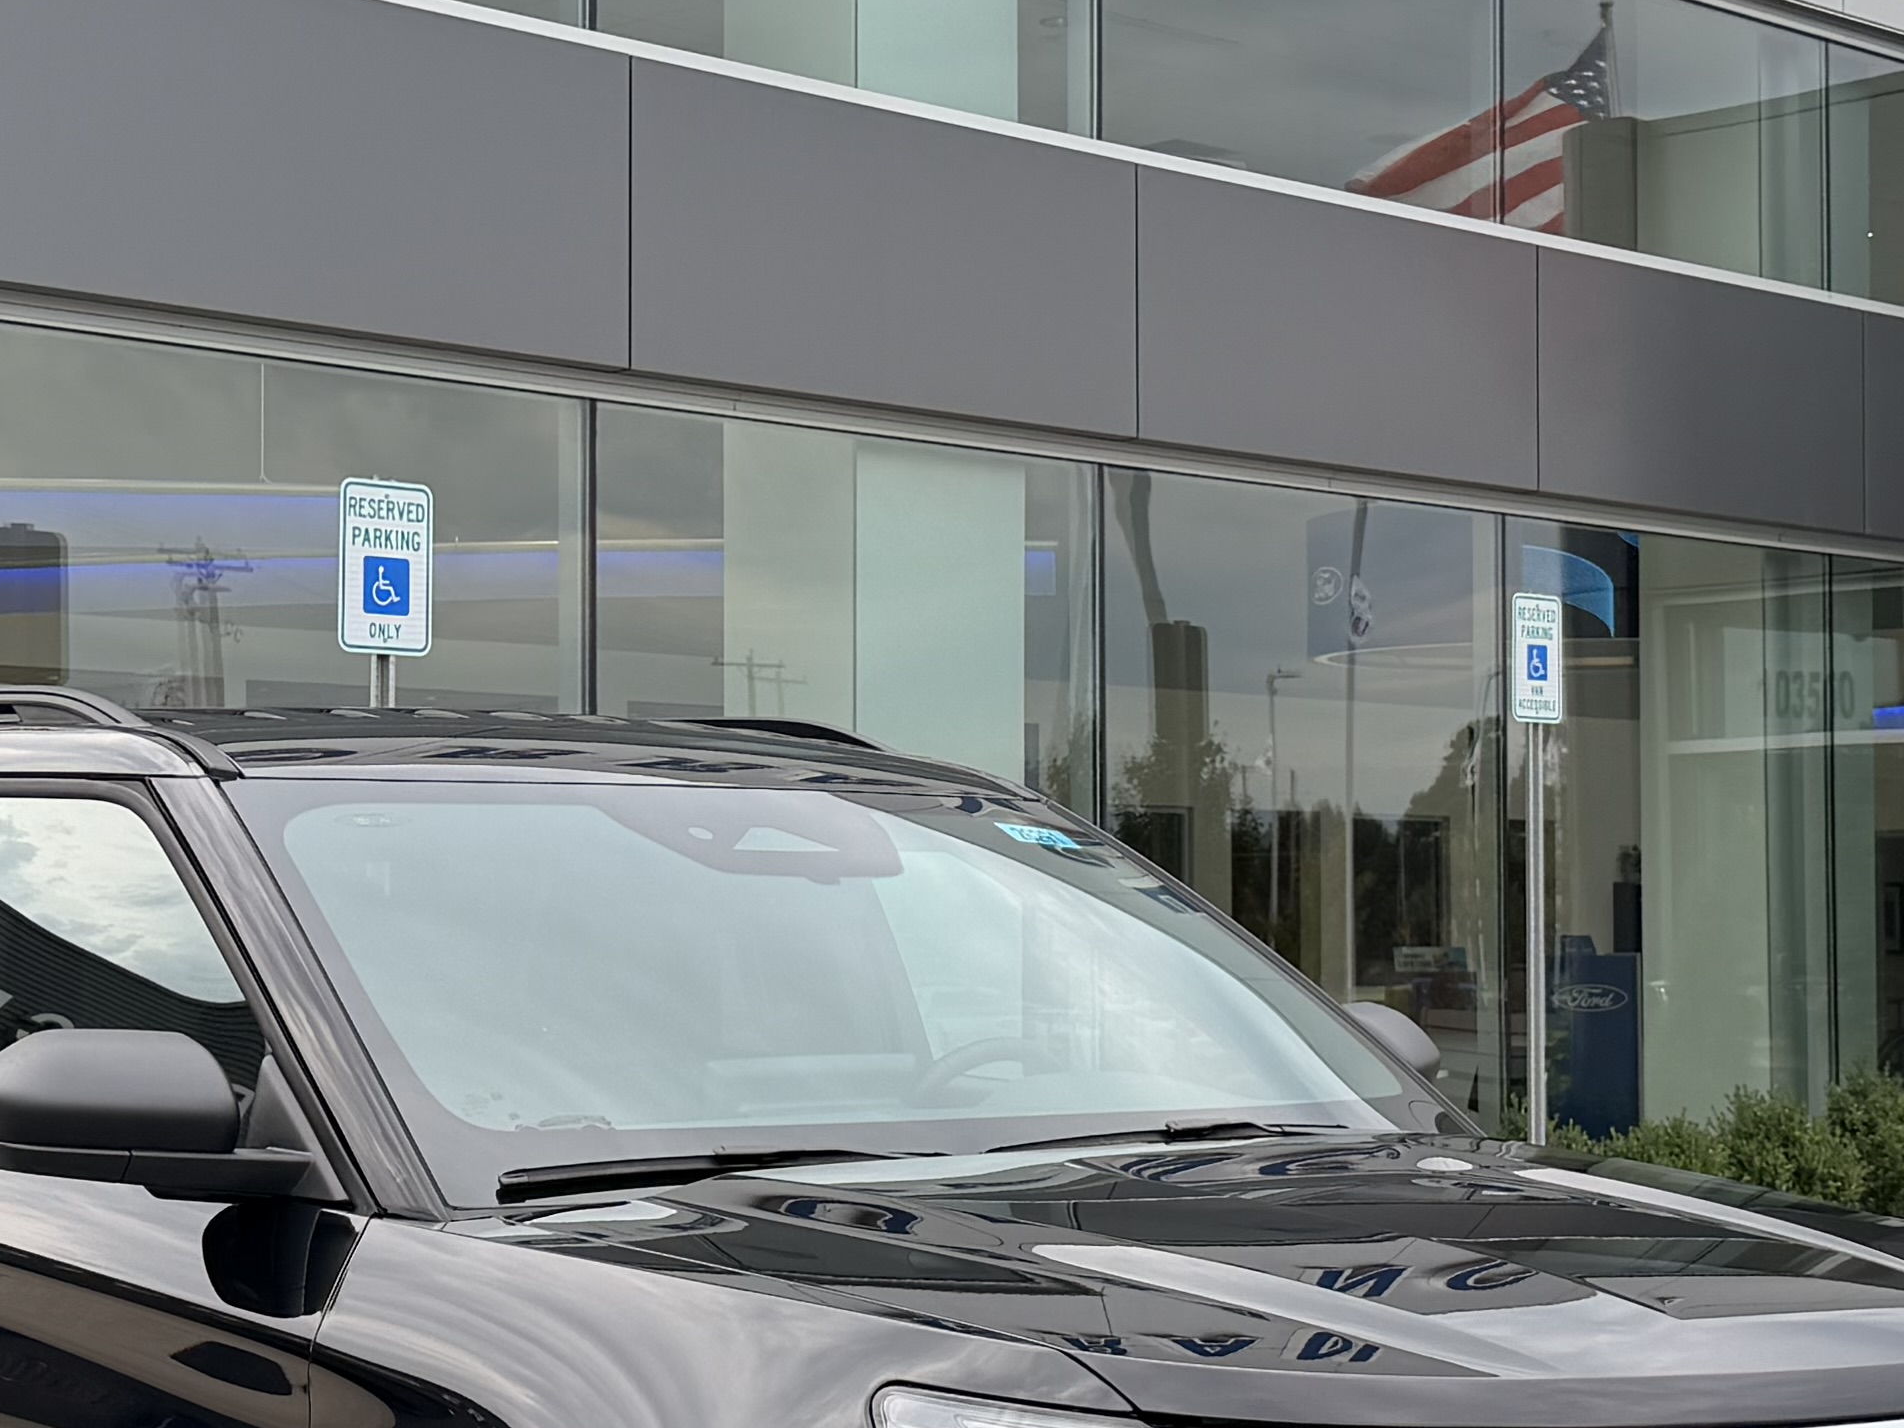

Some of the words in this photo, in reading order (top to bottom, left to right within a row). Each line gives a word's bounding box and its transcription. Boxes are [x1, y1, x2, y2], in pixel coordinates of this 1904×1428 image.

[348, 496, 425, 523] RESERVED
[352, 526, 421, 552] PARKING
[1518, 605, 1556, 623] RESERVED
[369, 623, 402, 641] ONLY
[1521, 624, 1553, 640] PARKING
[1567, 987, 1614, 1009] Ford
